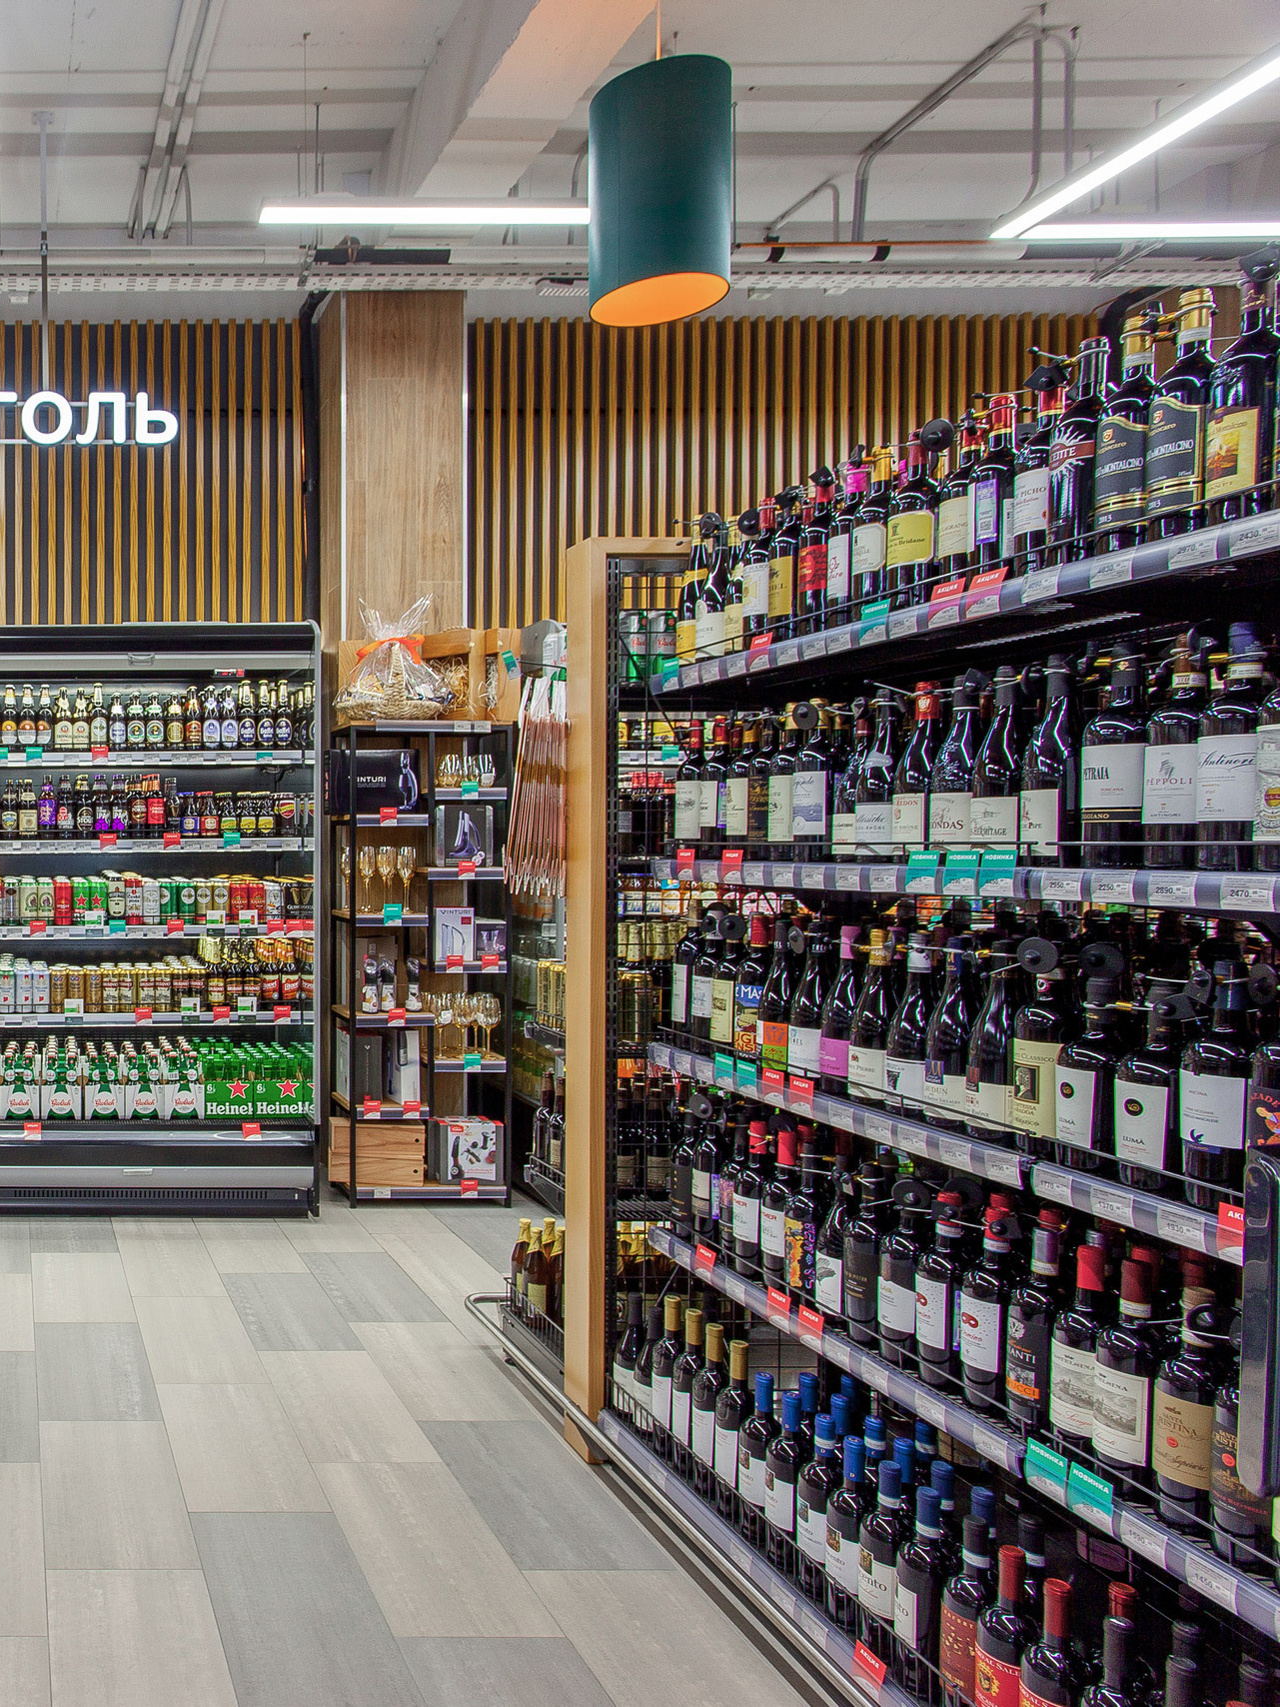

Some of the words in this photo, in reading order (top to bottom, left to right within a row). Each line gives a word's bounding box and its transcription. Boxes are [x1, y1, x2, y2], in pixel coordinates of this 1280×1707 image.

[976, 572, 1000, 584] АКЦИЯ
[936, 584, 958, 593] АКЦИЯ
[765, 1071, 780, 1079] АКЦИЯ
[793, 1080, 809, 1088] АКЦИЯ
[1030, 1443, 1064, 1468] НОВИНКА
[1073, 1468, 1110, 1495] НОВИНКА
